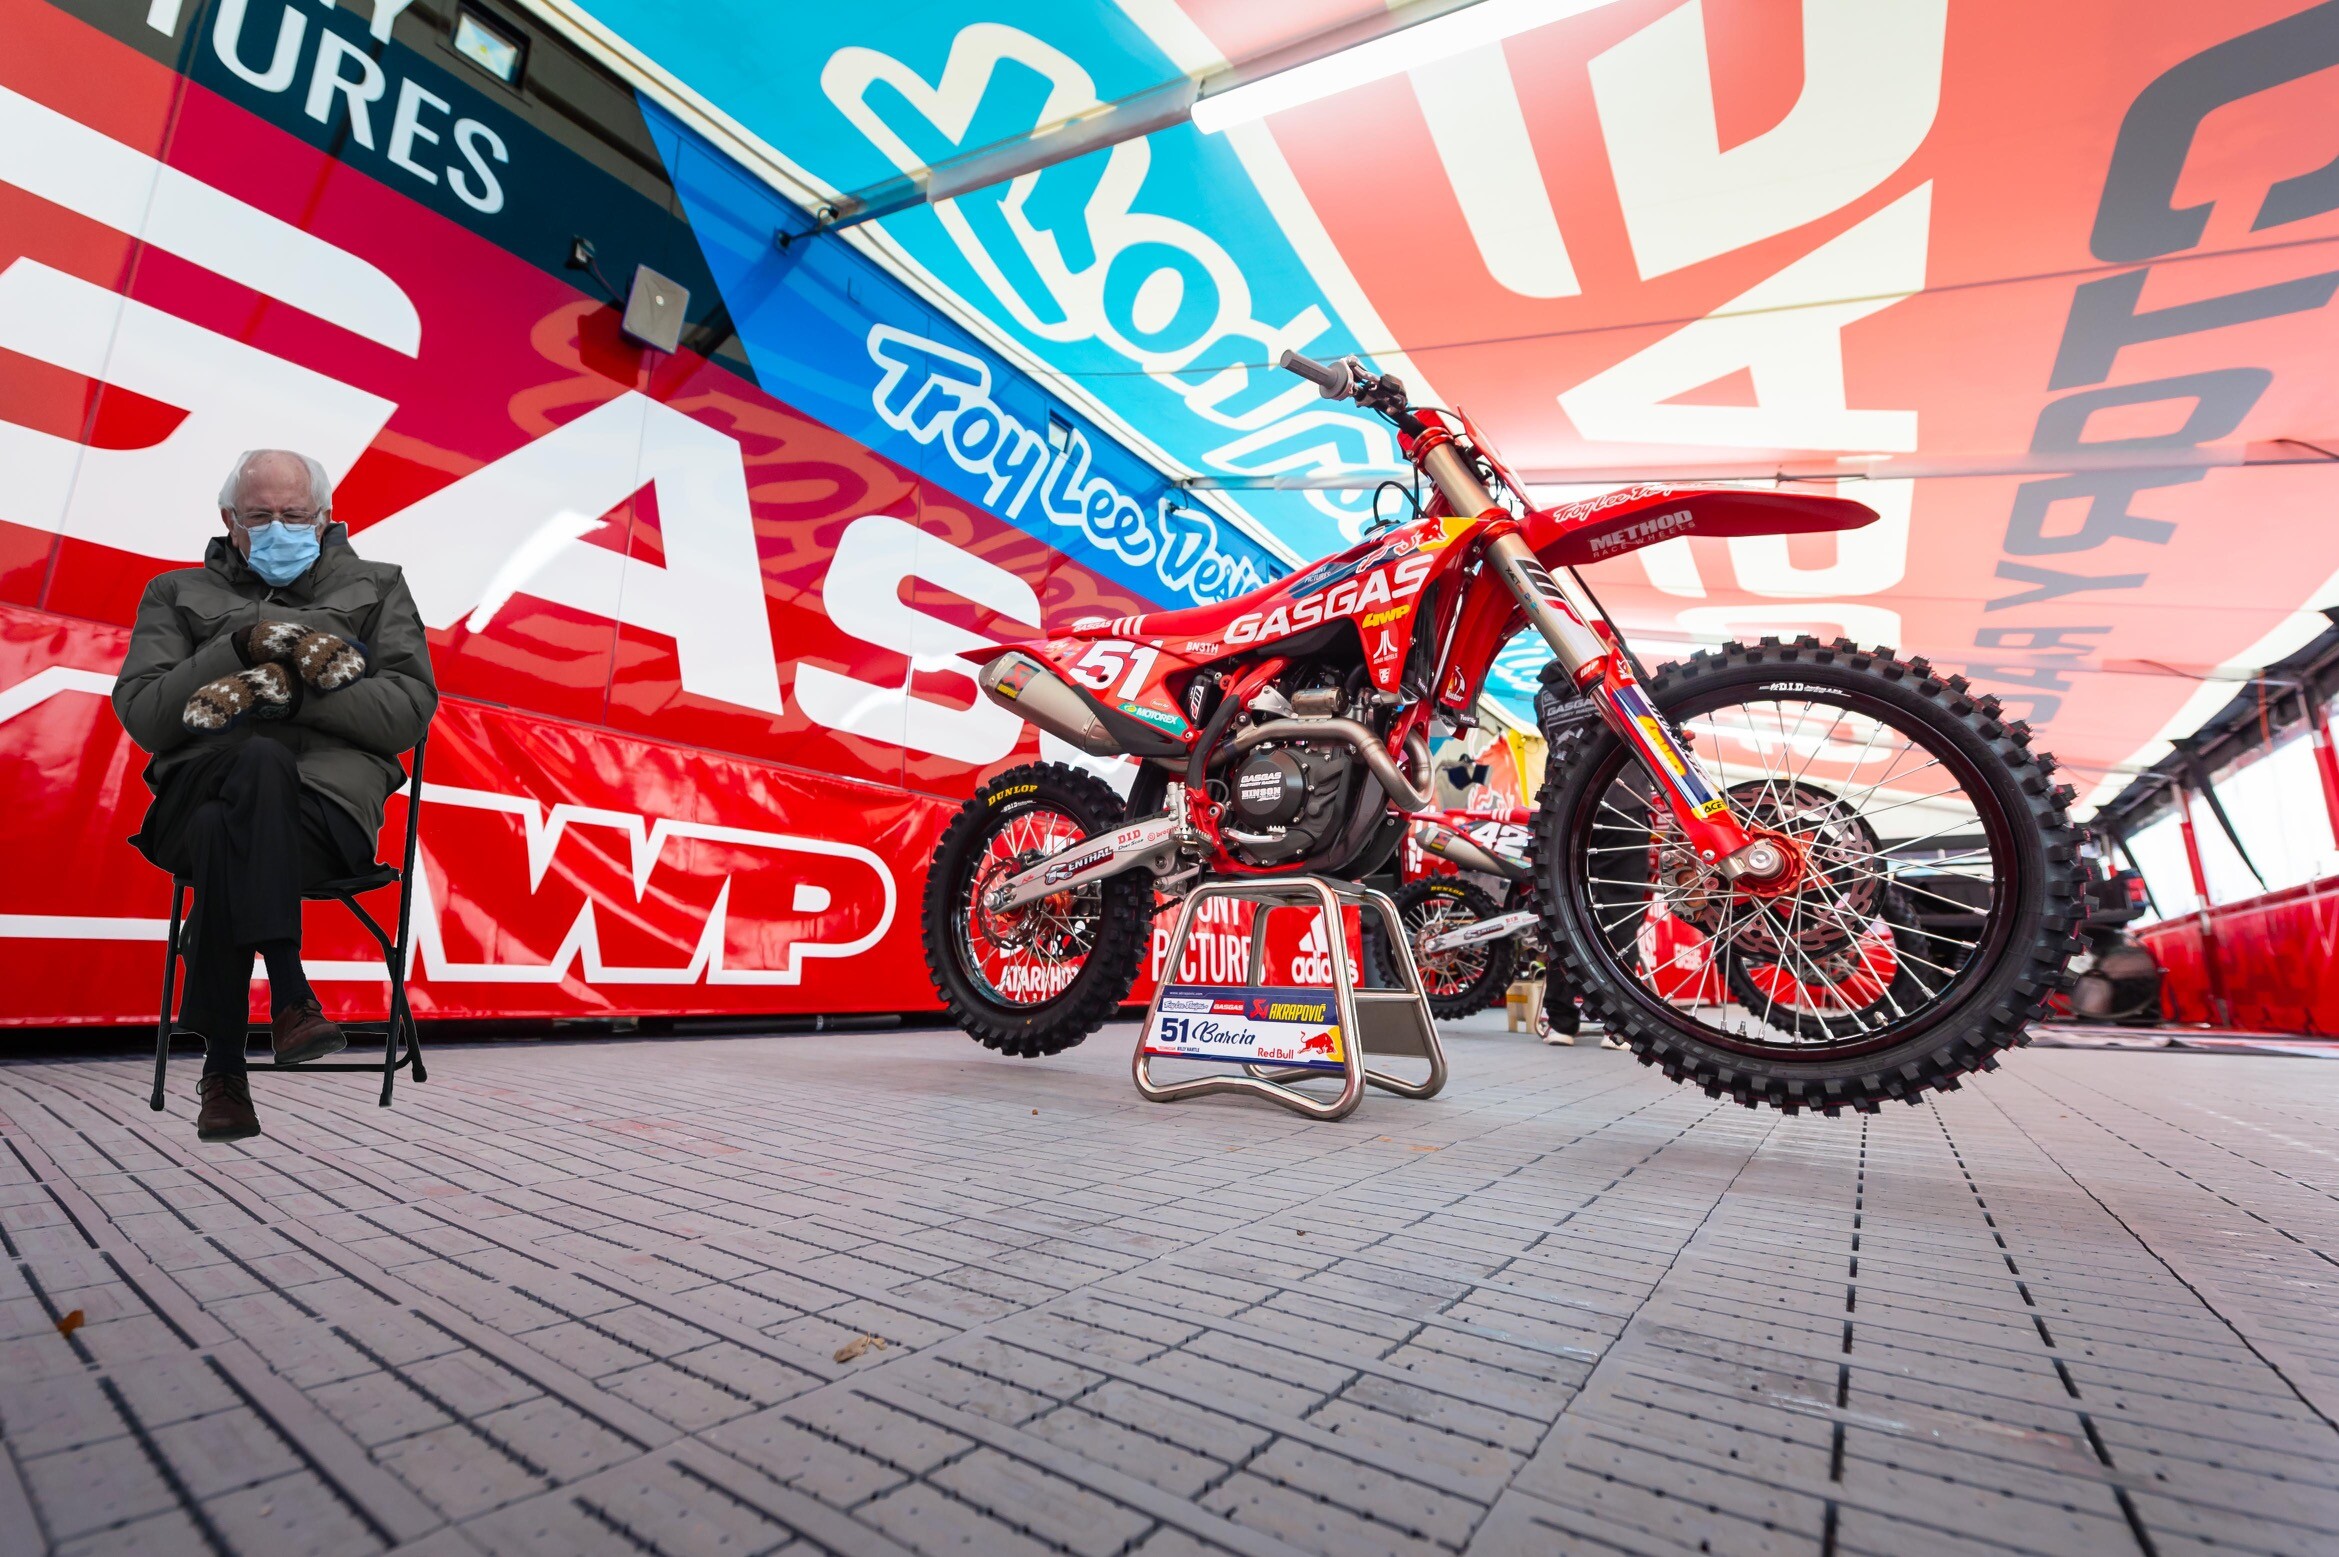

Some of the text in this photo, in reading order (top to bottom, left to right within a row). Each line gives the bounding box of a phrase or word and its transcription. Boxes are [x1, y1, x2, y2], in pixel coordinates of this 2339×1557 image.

[0, 85, 1140, 800] GAS
[866, 322, 1051, 520] Troy
[1040, 427, 1157, 567] Lee
[1553, 502, 1594, 523] Troy
[1594, 493, 1632, 511] Lee
[1589, 509, 1693, 552] METHOD
[1593, 522, 1697, 559] RACE WHEELS
[1223, 553, 1435, 645] GASGAS
[1072, 620, 1113, 633] GASGAS
[1185, 640, 1220, 655] BN3TH
[1067, 638, 1164, 702] 51
[1136, 707, 1178, 725] MOTOREX
[1546, 698, 1596, 717] GASGA
[1240, 771, 1283, 784] GASGAS
[988, 784, 1038, 807] DUNLOP
[1469, 821, 1530, 859] 42
[1430, 885, 1465, 897] DUNLOP
[1195, 896, 1240, 926] ONY
[1151, 928, 1266, 984] PCTURE
[1213, 1003, 1244, 1011] GASGAS
[1269, 1003, 1327, 1023] AKRAPOVIČ
[1160, 1017, 1256, 1045] 51 Barcia
[1257, 1047, 1294, 1060] Red Bull
